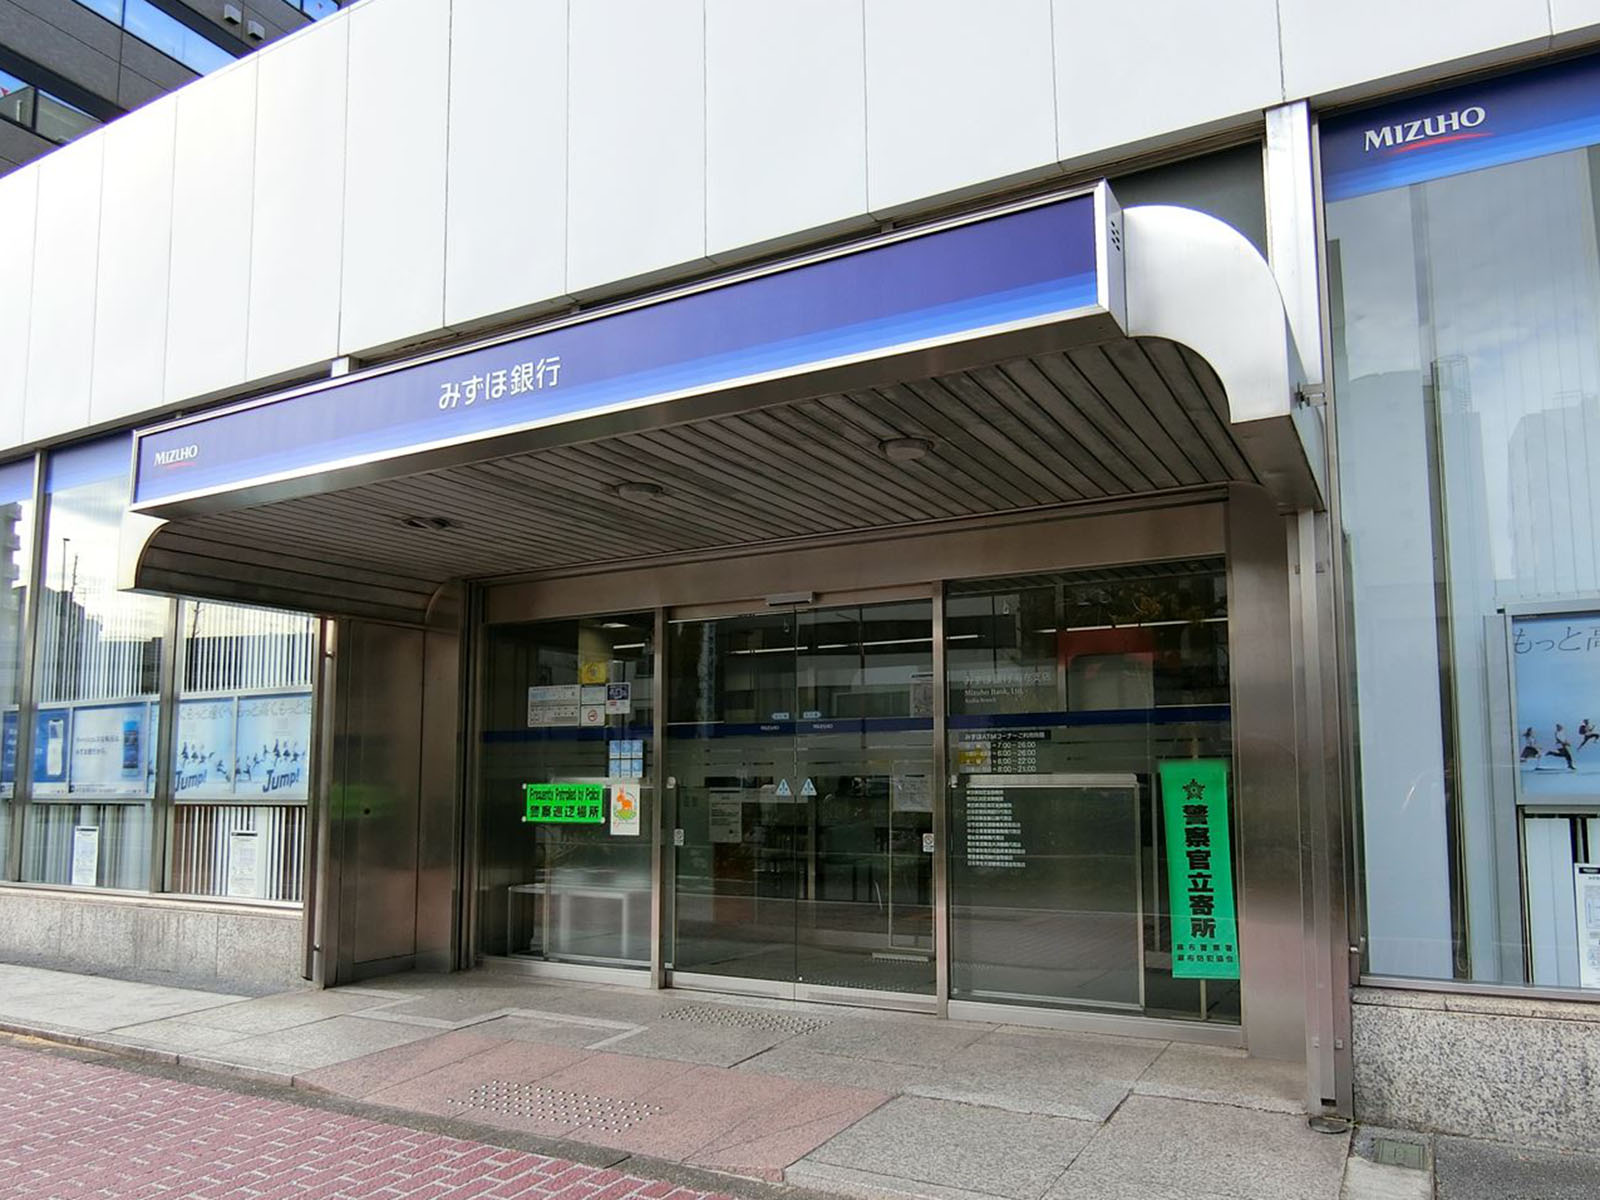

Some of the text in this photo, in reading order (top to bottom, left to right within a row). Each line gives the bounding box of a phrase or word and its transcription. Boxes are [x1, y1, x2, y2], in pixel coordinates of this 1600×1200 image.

[1364, 107, 1486, 151] MIZUHO
[439, 357, 560, 410] みずほ銀行
[154, 445, 198, 467] MIZUHO
[262, 768, 300, 793] Jump!
[1182, 804, 1217, 939] 警察官立寄所
